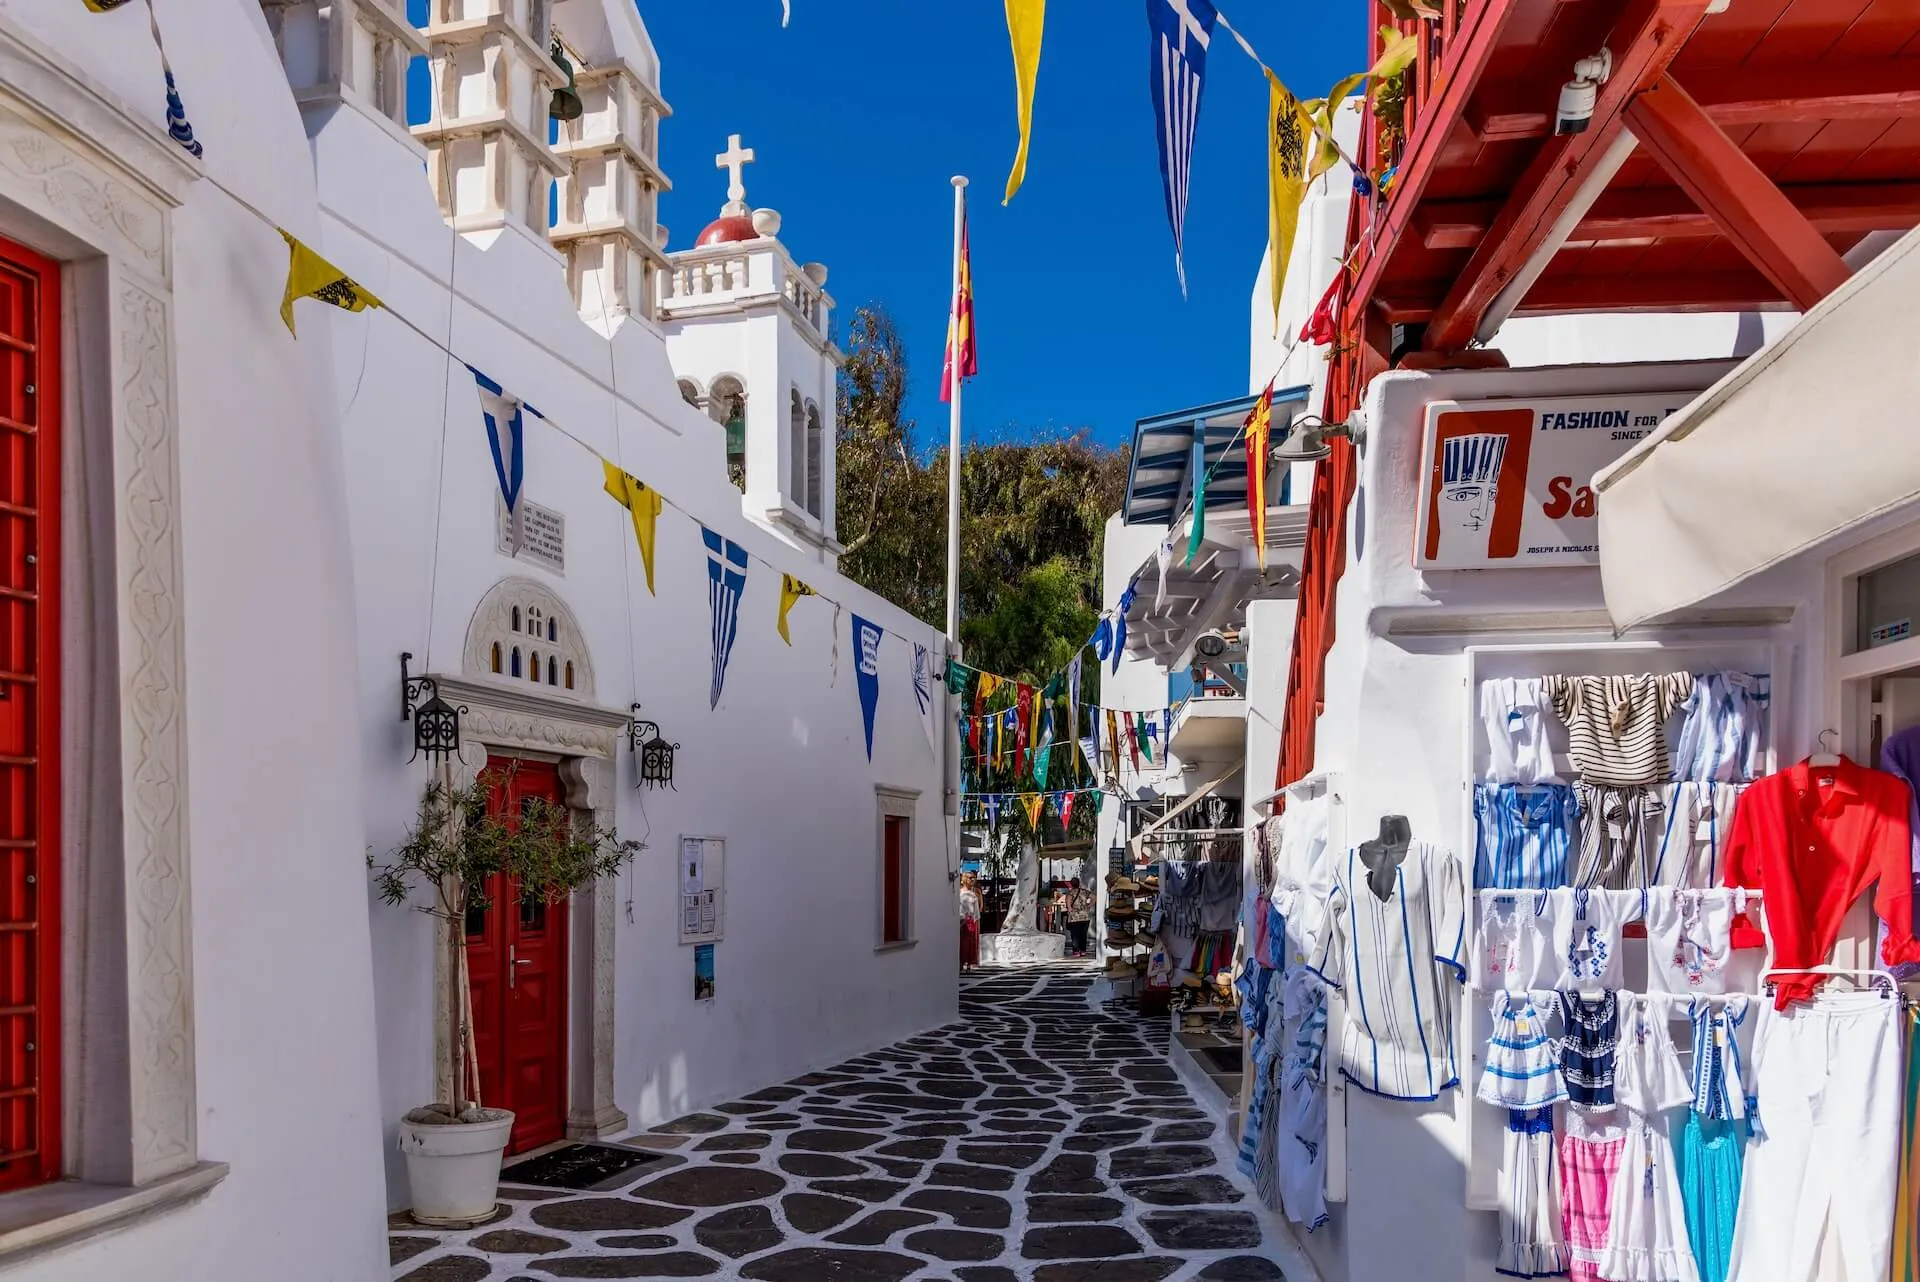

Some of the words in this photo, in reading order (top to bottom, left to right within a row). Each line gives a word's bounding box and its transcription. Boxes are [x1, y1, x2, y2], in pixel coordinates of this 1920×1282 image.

[1541, 410, 1629, 430] FASHION
[1634, 416, 1657, 426] FOR
[1611, 430, 1642, 440] SINCE
[1543, 476, 1598, 519] Sa
